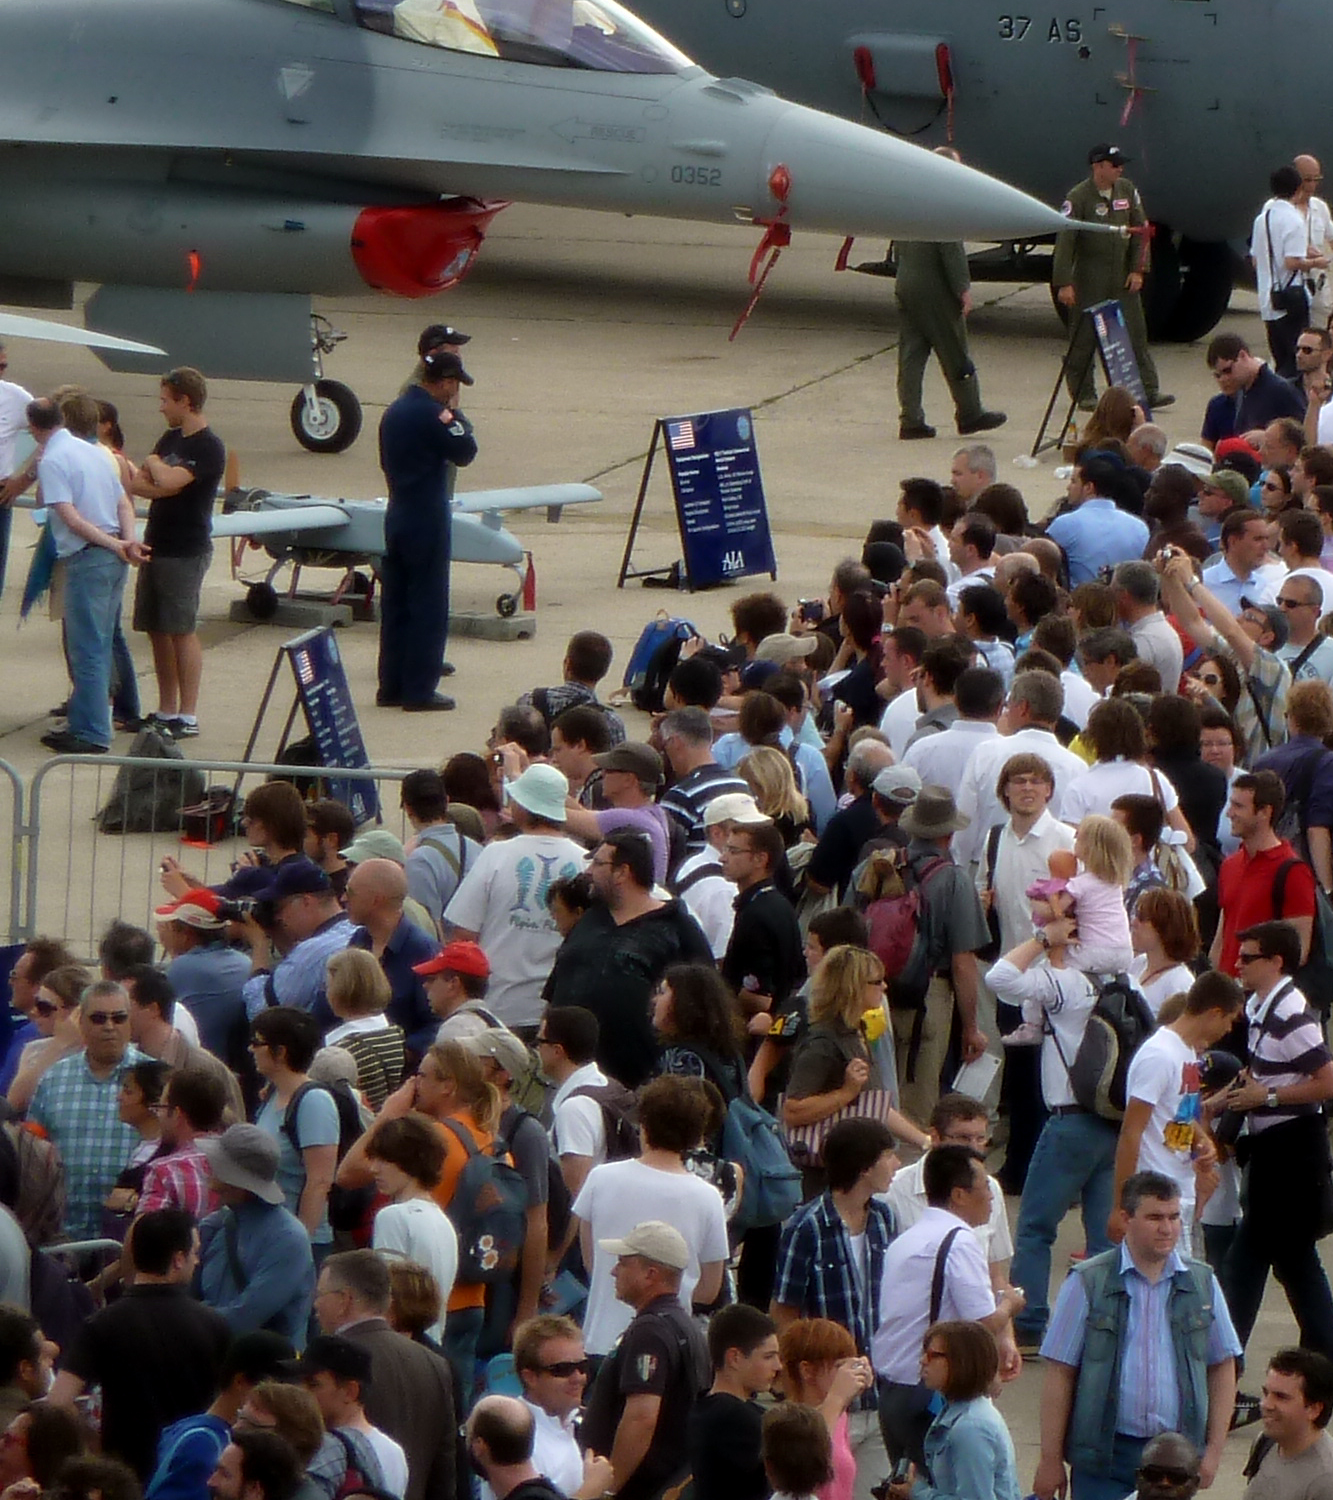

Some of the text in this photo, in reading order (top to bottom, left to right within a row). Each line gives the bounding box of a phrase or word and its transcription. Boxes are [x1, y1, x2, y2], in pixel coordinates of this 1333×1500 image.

[998, 14, 1083, 44] 37 AS
[671, 164, 722, 187] 0352
